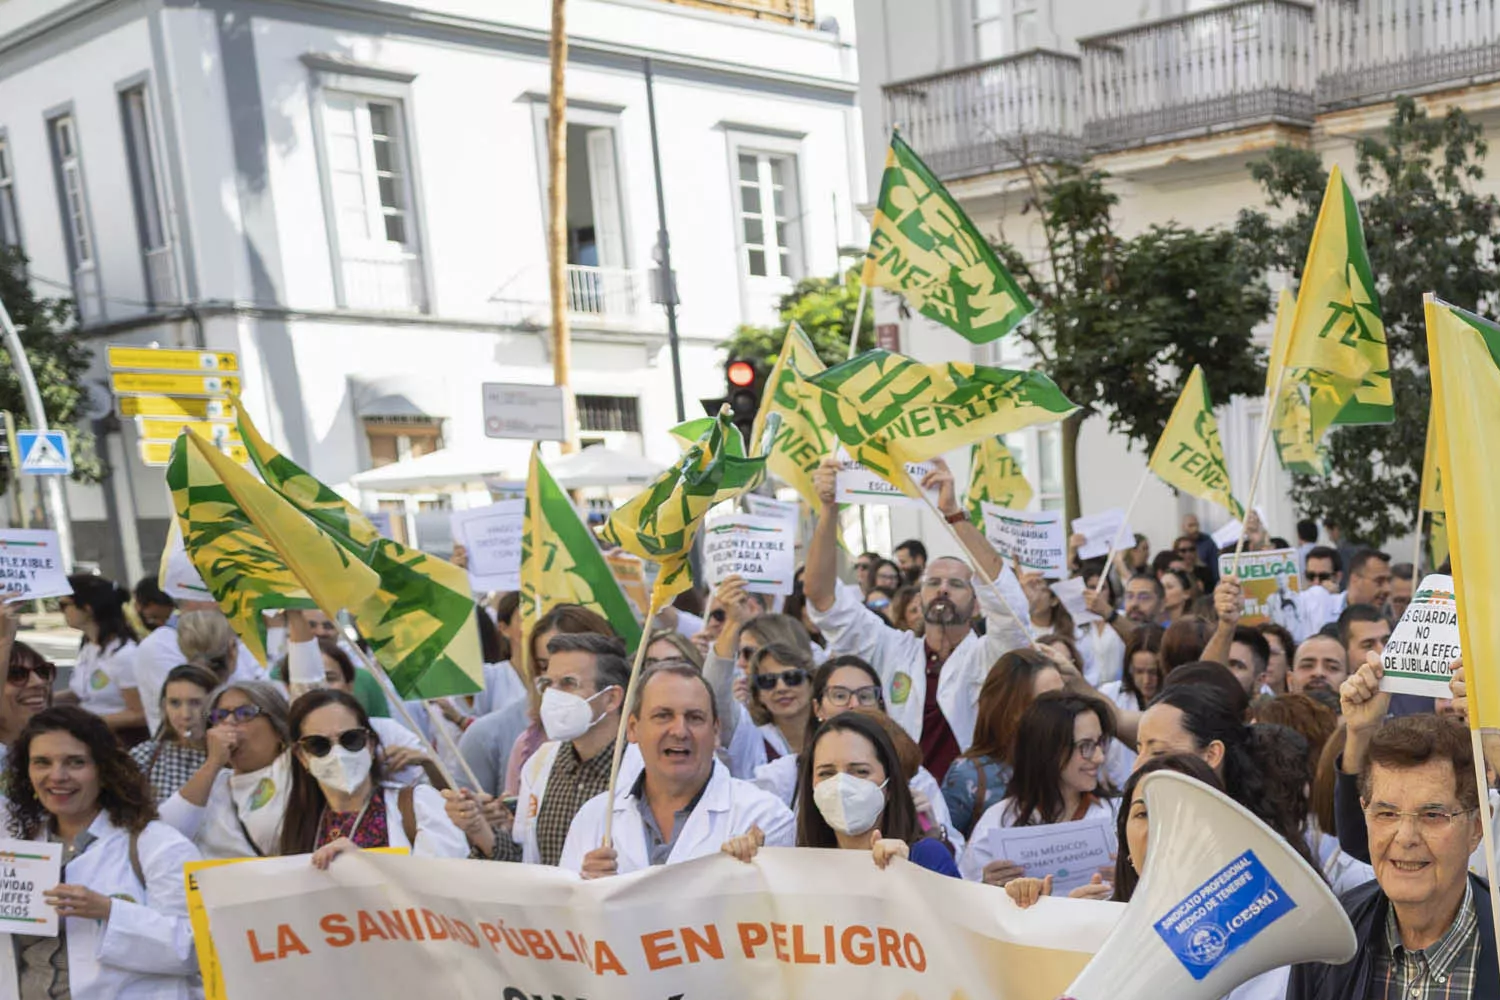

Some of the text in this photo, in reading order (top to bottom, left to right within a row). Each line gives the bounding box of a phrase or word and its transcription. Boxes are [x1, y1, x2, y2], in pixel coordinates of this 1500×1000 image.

[1411, 609, 1457, 626] GUARDIA
[1415, 626, 1430, 640] NO
[1386, 641, 1459, 659] PUTAN A EFEC
[1384, 656, 1398, 670] DE
[1020, 840, 1089, 860] SIN MÉDICOS
[1033, 859, 1055, 869] HAY
[1057, 848, 1104, 865] SANIDAD
[3, 868, 17, 878] LA
[1161, 856, 1254, 930] SINDICATO PROFESIONAL
[1175, 870, 1254, 935] MEDICO DE TENERIFE
[1226, 888, 1279, 934] (CESM)
[245, 907, 928, 977] LA SANIDAD PÚBLICA EN PELIGRO
